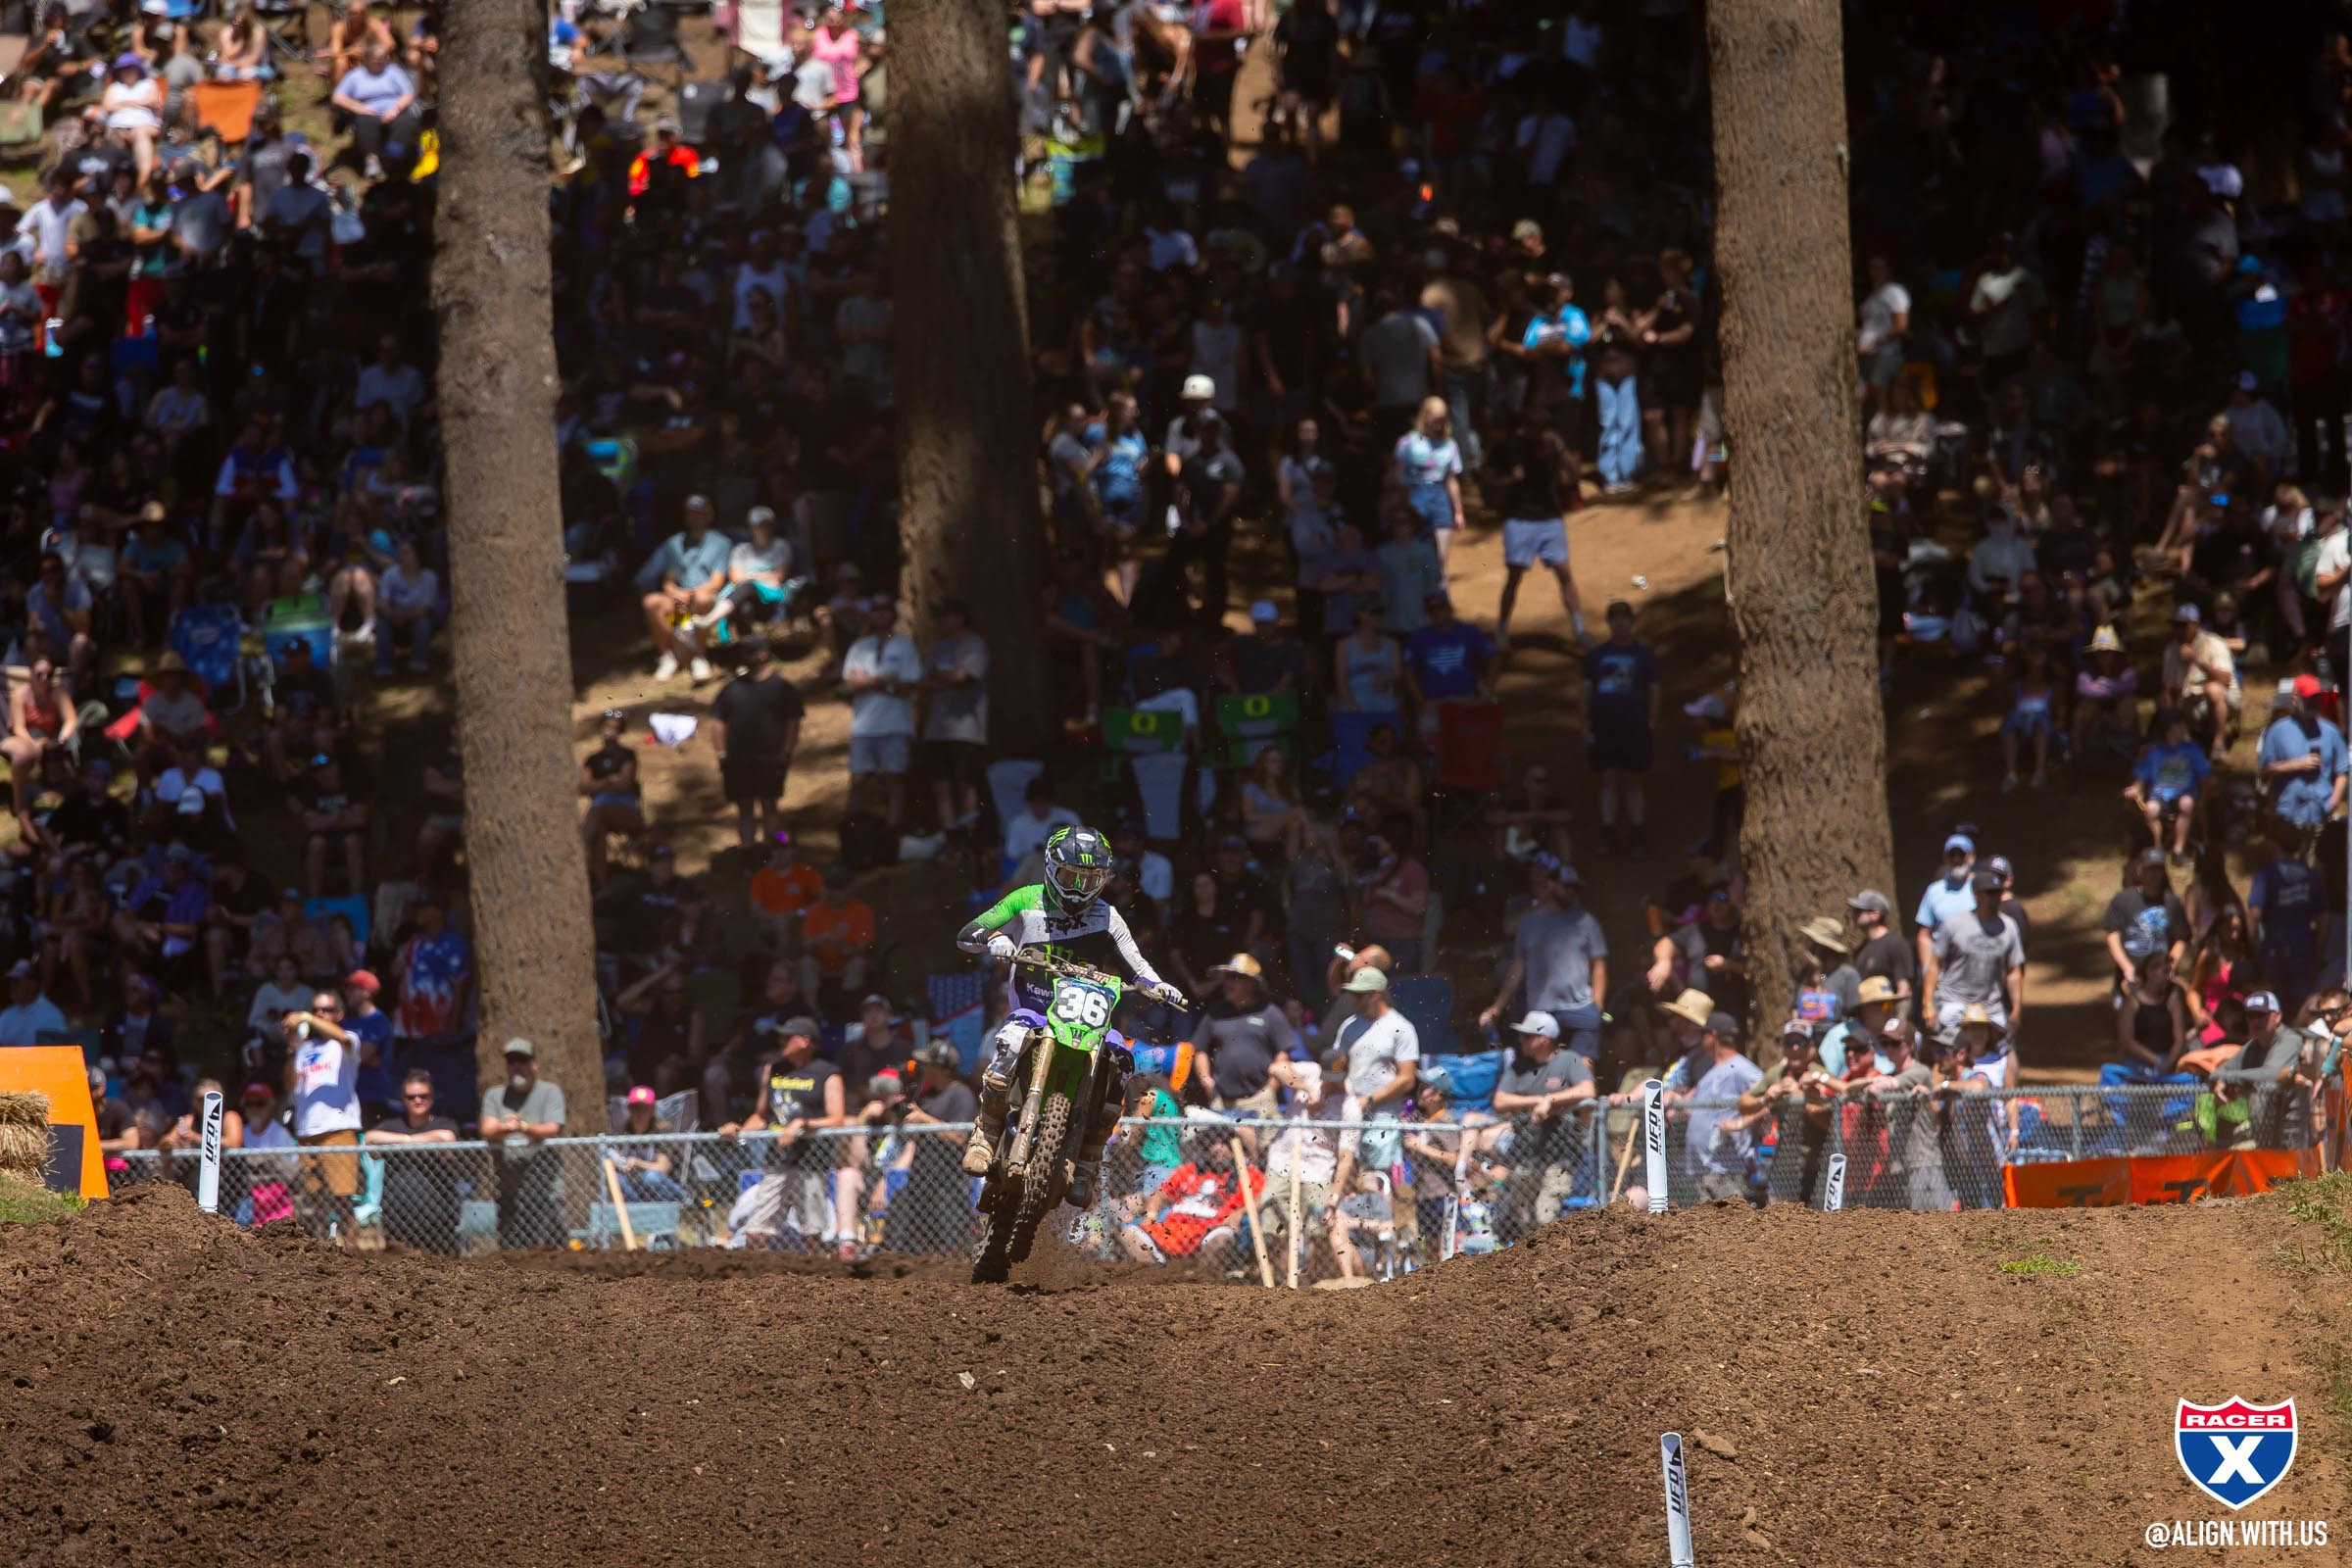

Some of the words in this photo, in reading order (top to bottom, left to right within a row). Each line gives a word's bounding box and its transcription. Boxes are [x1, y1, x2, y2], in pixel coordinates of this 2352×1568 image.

[1044, 914, 1088, 935] FOX
[1057, 986, 1108, 1027] 36
[206, 1121, 216, 1163] UFO
[1649, 1109, 1659, 1153] UFO
[1668, 1468, 1682, 1515] UFO
